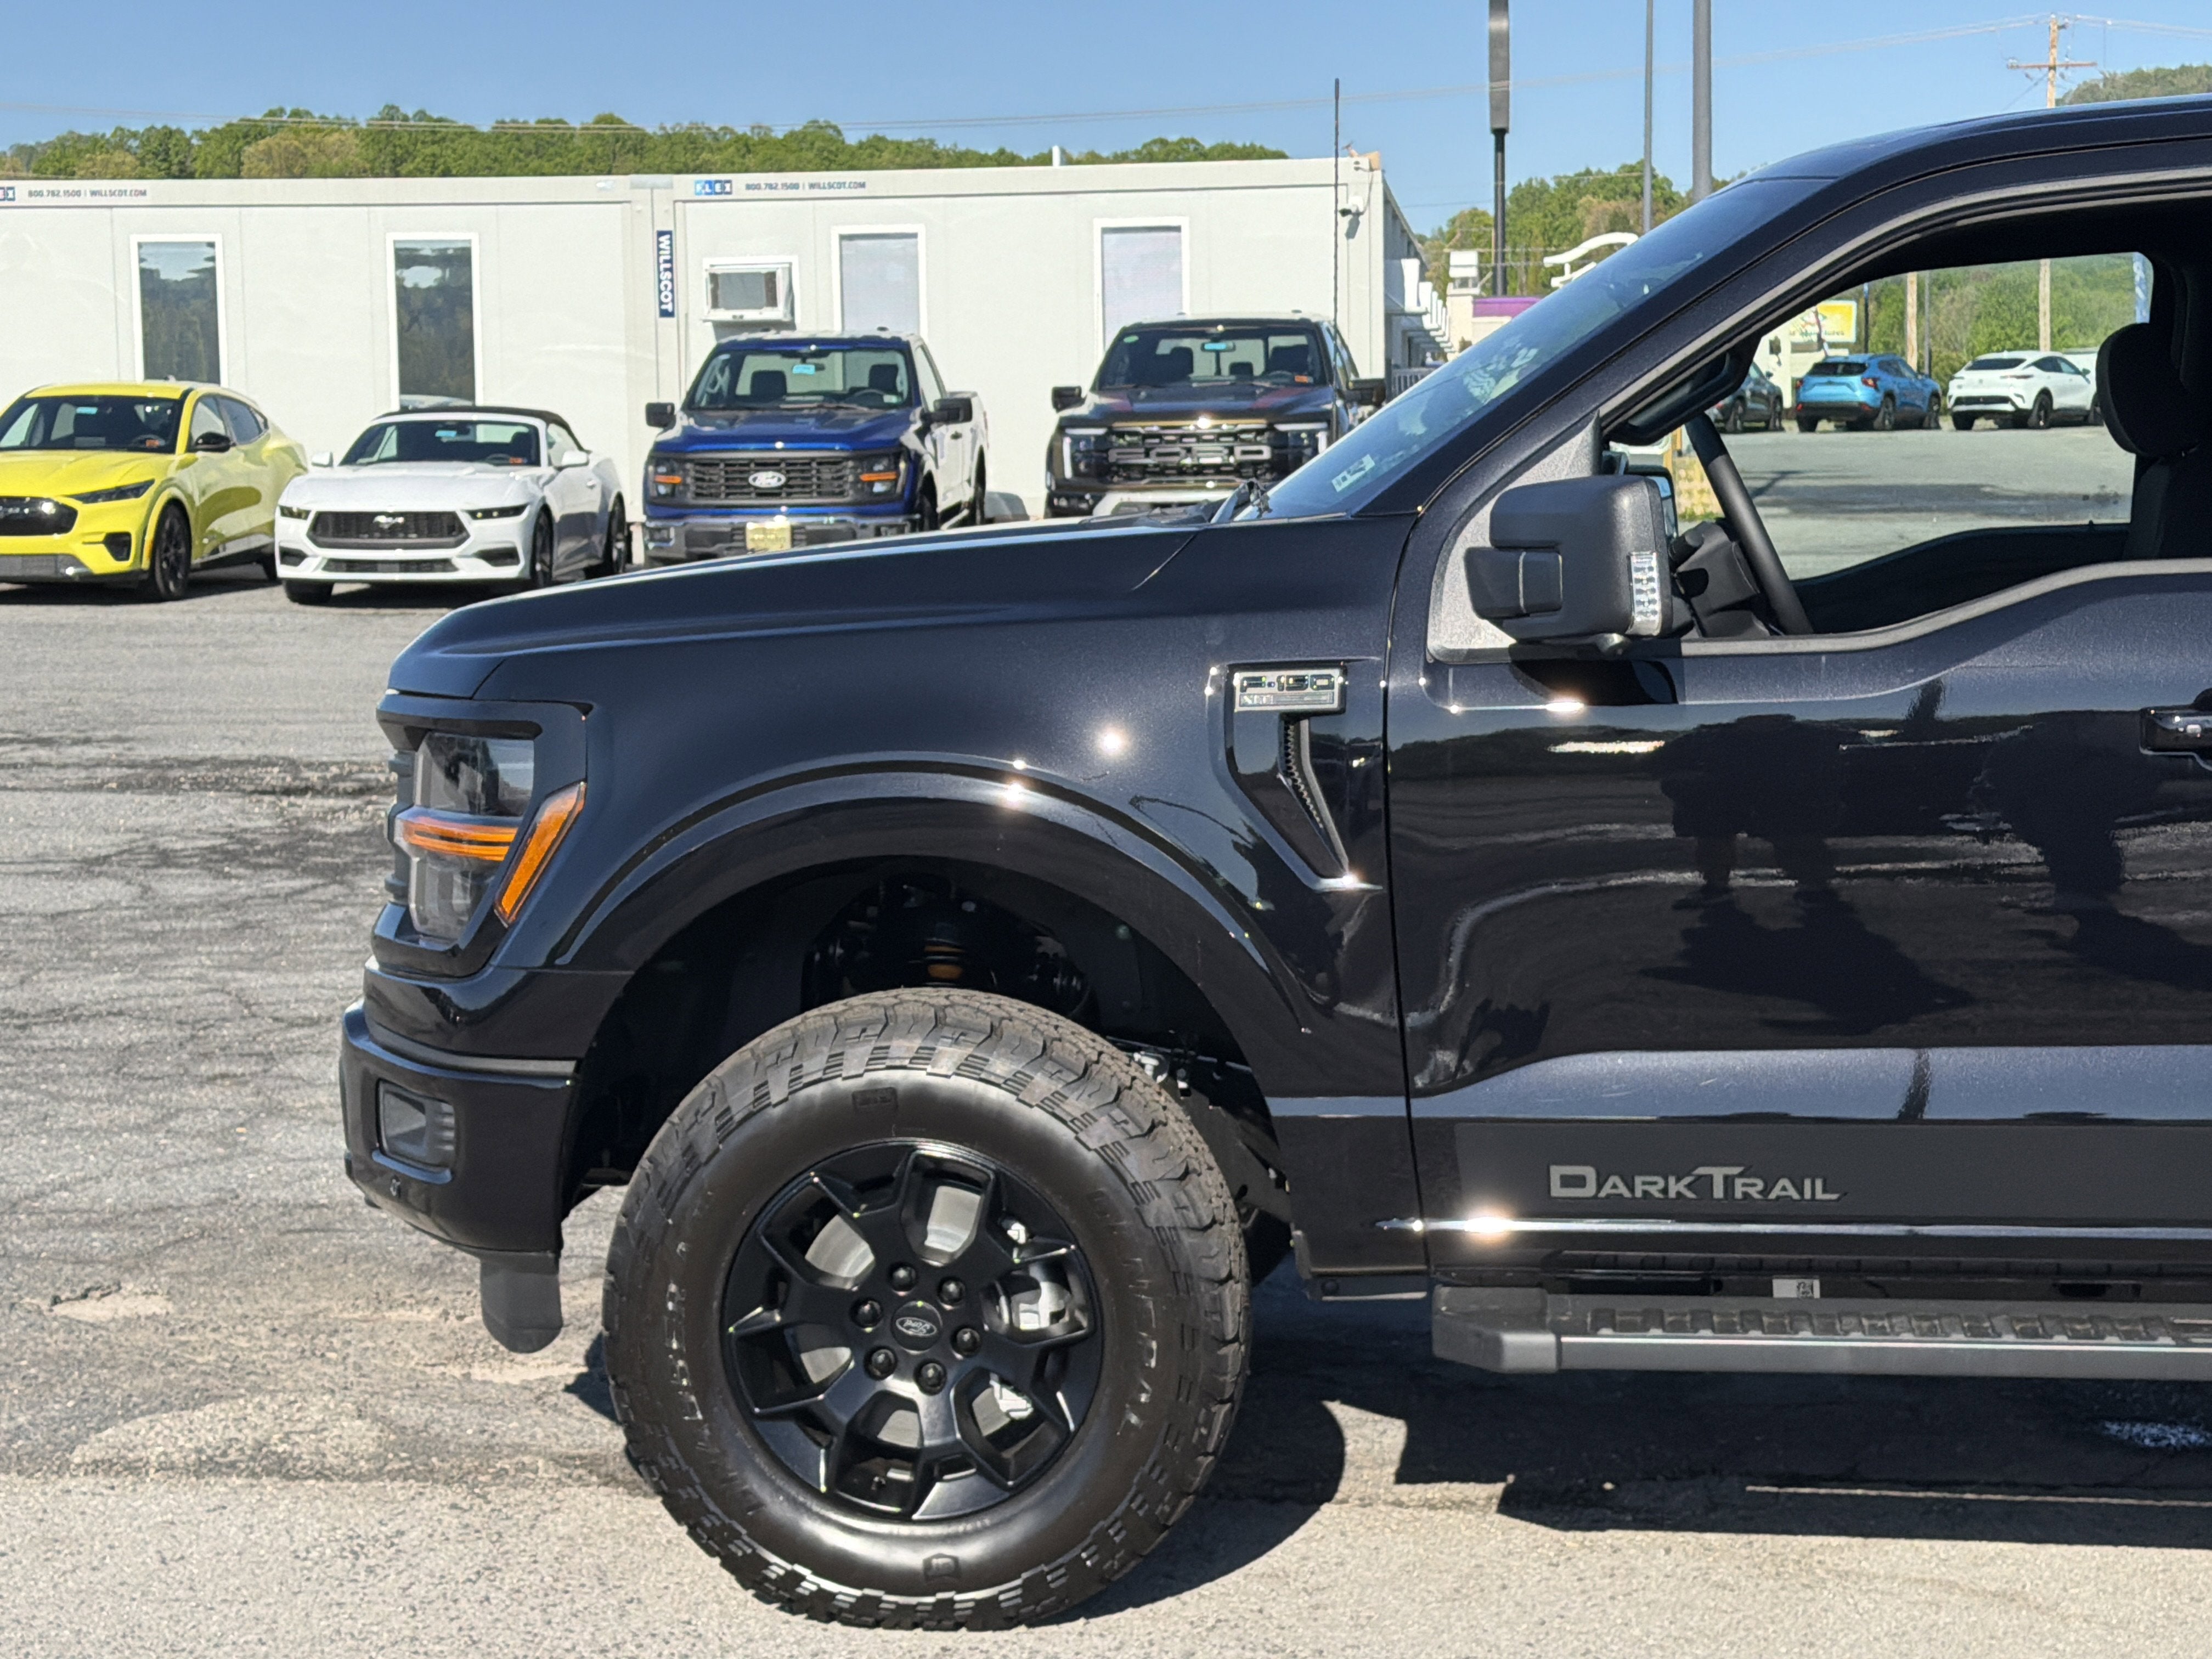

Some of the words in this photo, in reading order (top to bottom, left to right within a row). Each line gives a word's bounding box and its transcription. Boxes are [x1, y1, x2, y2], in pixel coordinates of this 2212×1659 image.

[808, 181, 866, 190] WILLSCOT.COM
[89, 189, 147, 198] WILLSCOT.COM
[658, 234, 673, 313] WILLSCOT
